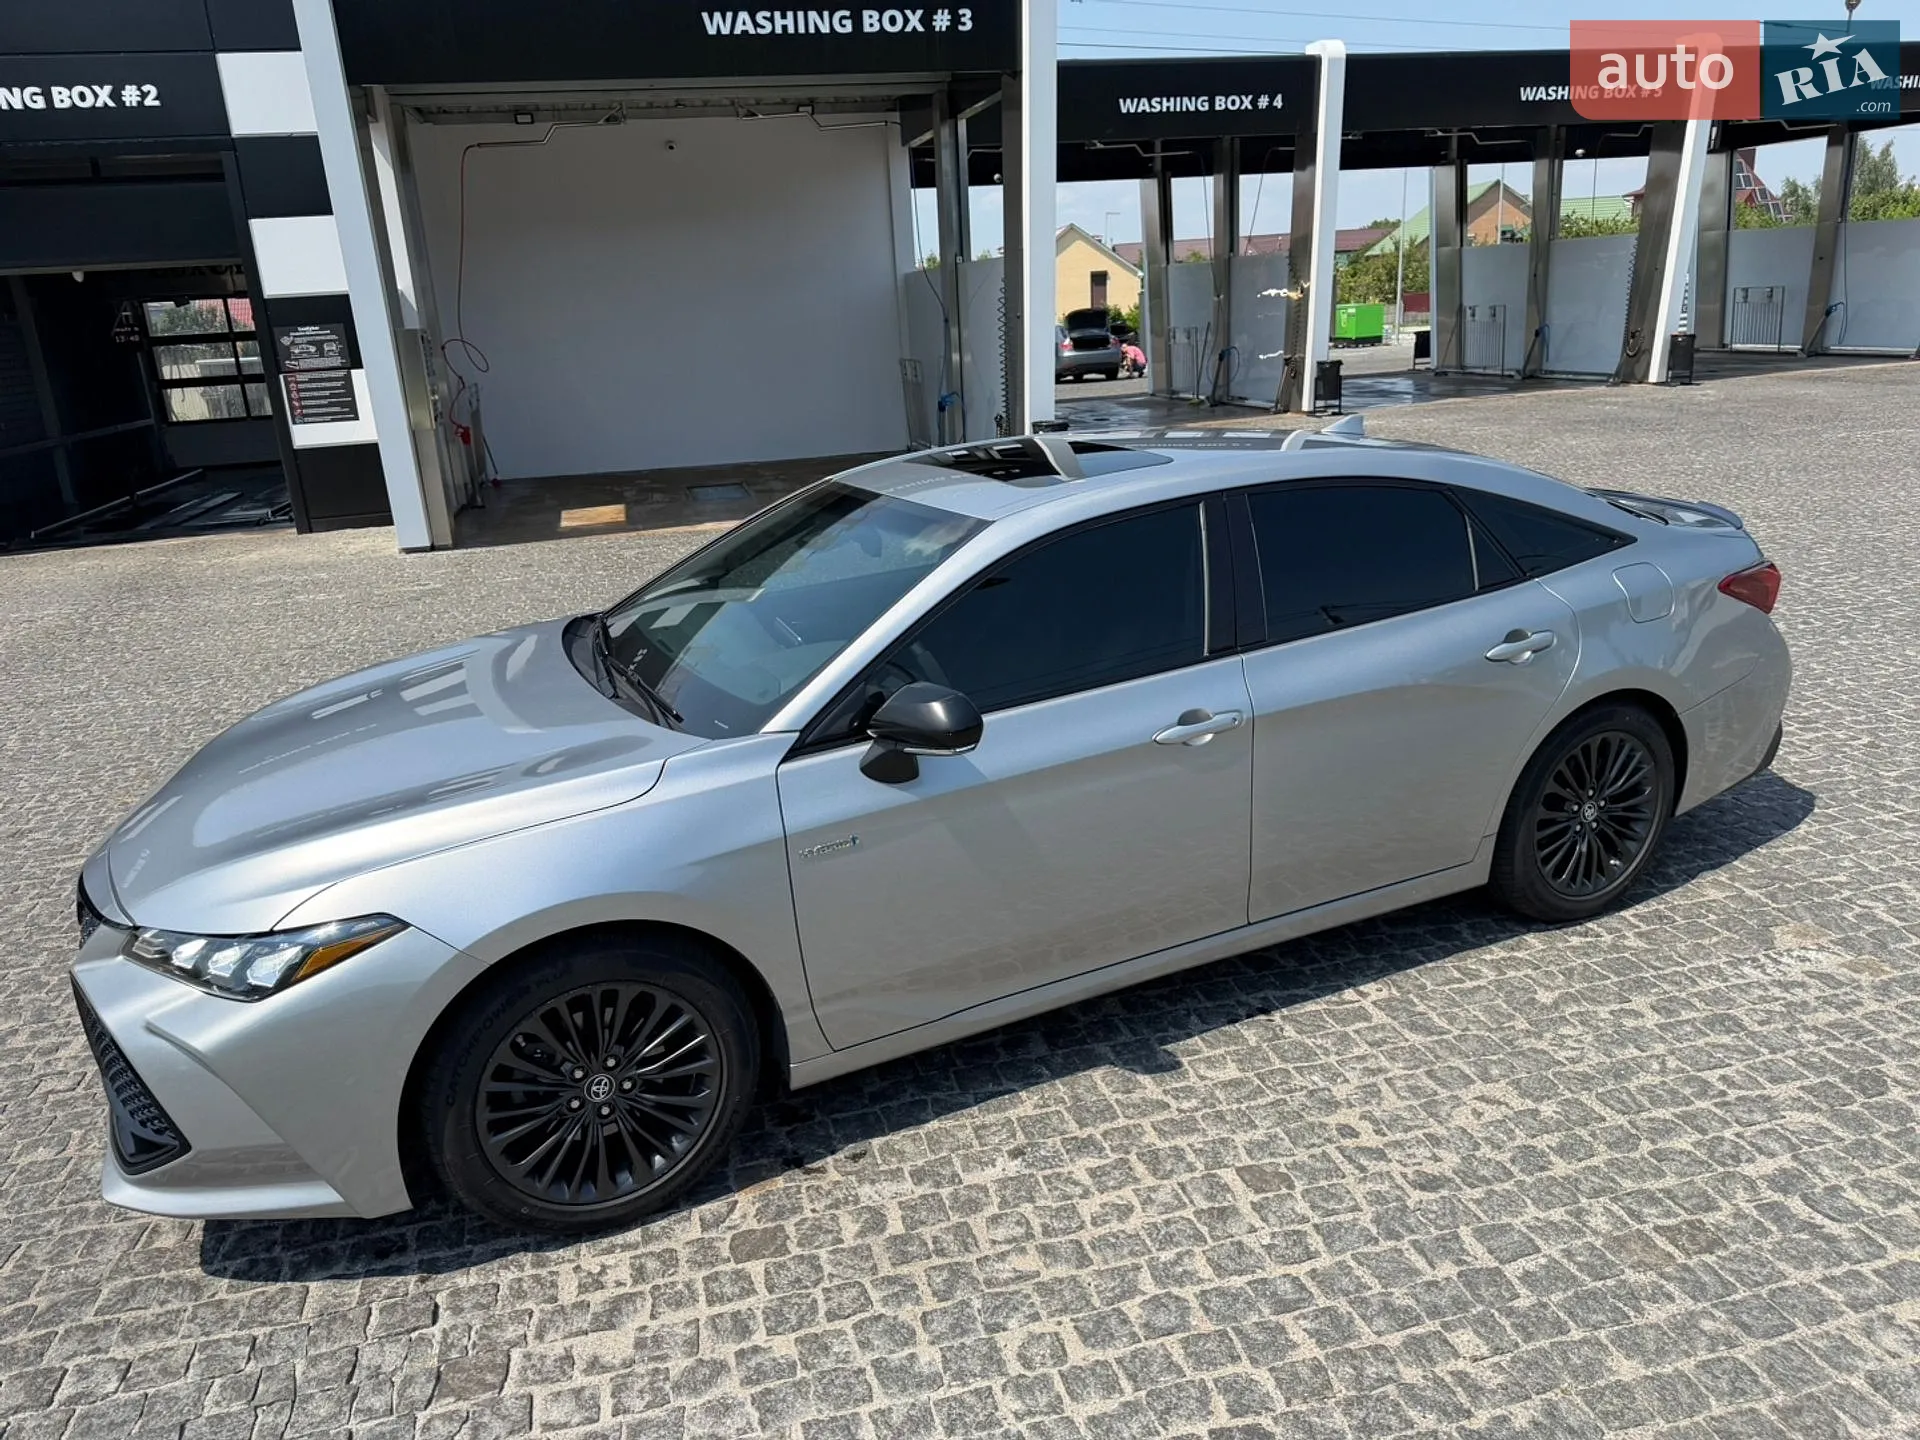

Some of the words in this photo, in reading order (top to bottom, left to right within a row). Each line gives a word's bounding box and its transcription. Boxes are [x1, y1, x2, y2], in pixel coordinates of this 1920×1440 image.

[701, 10, 853, 36] WASHING
[862, 9, 926, 34] BOX
[1519, 84, 1600, 101] WASHING
[1603, 84, 1638, 99] BOX
[1870, 75, 1920, 90] WASHI
[50, 84, 117, 109] BOX
[120, 83, 162, 107] #2
[1118, 95, 1210, 114] WASHING
[1214, 94, 1254, 111] BOX
